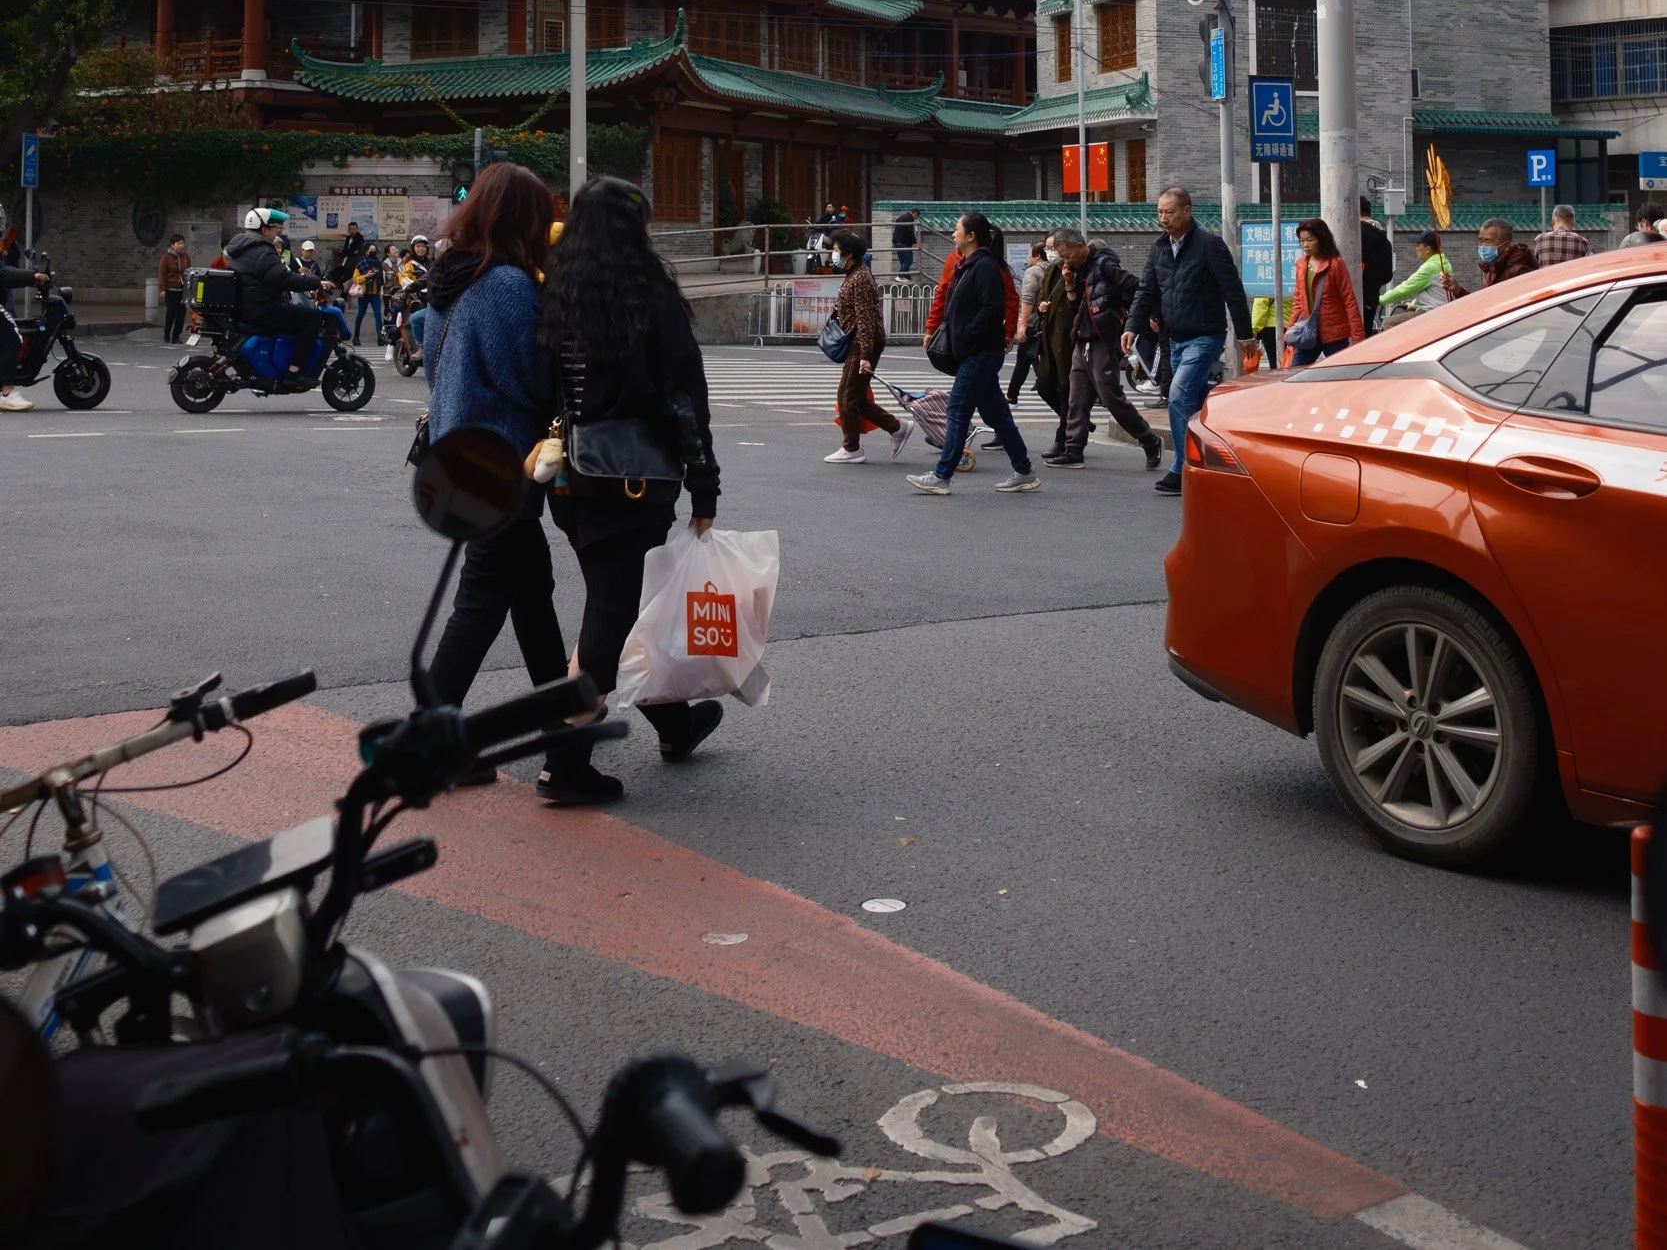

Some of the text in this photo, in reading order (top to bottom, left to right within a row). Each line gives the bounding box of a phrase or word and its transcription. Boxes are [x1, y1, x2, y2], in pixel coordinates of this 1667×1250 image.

[1255, 142, 1295, 157] 无障碍通道
[1530, 155, 1547, 182] P
[693, 601, 731, 623] MIN
